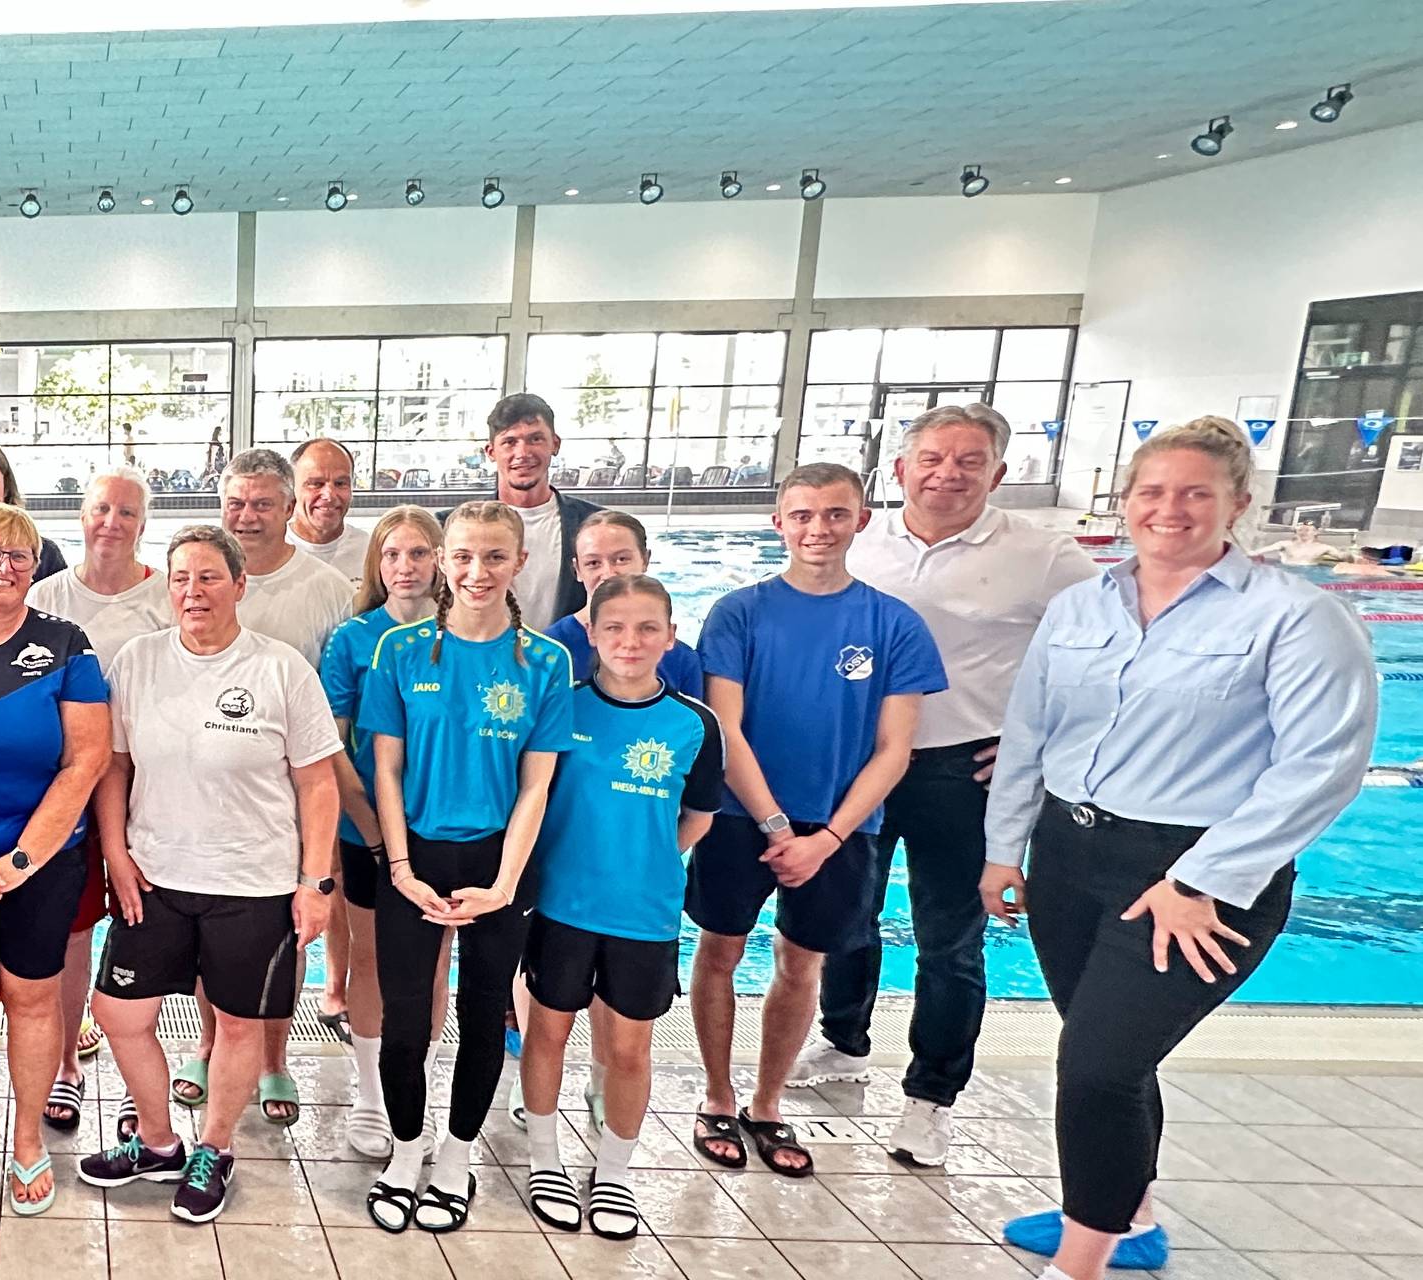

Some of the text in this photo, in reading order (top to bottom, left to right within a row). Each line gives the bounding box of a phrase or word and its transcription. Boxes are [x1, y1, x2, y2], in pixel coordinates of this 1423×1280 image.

[844, 653, 866, 672] OSV
[413, 682, 441, 693] JAKO
[204, 721, 259, 735] Christiane
